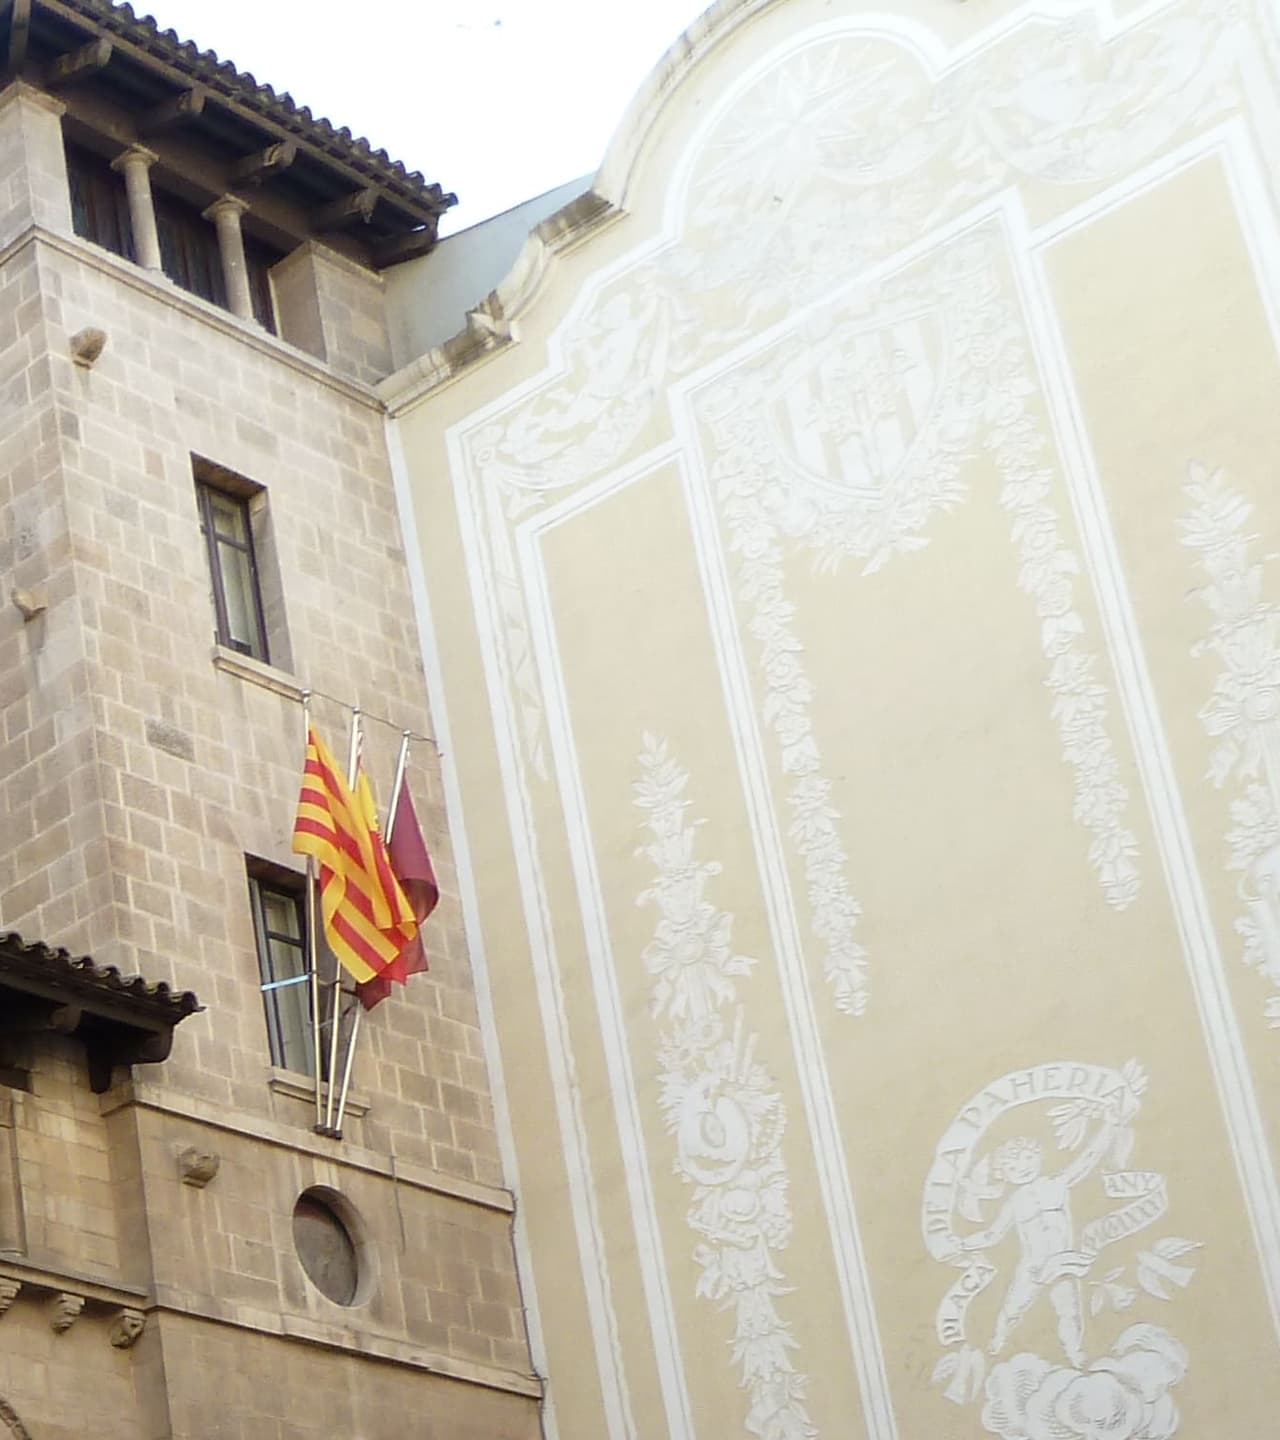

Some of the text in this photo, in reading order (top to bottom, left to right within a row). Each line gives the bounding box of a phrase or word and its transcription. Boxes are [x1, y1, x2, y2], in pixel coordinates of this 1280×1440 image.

[959, 1066, 1127, 1128] PAHERIA
[930, 1147, 967, 1187] LA
[925, 1201, 950, 1234] DE
